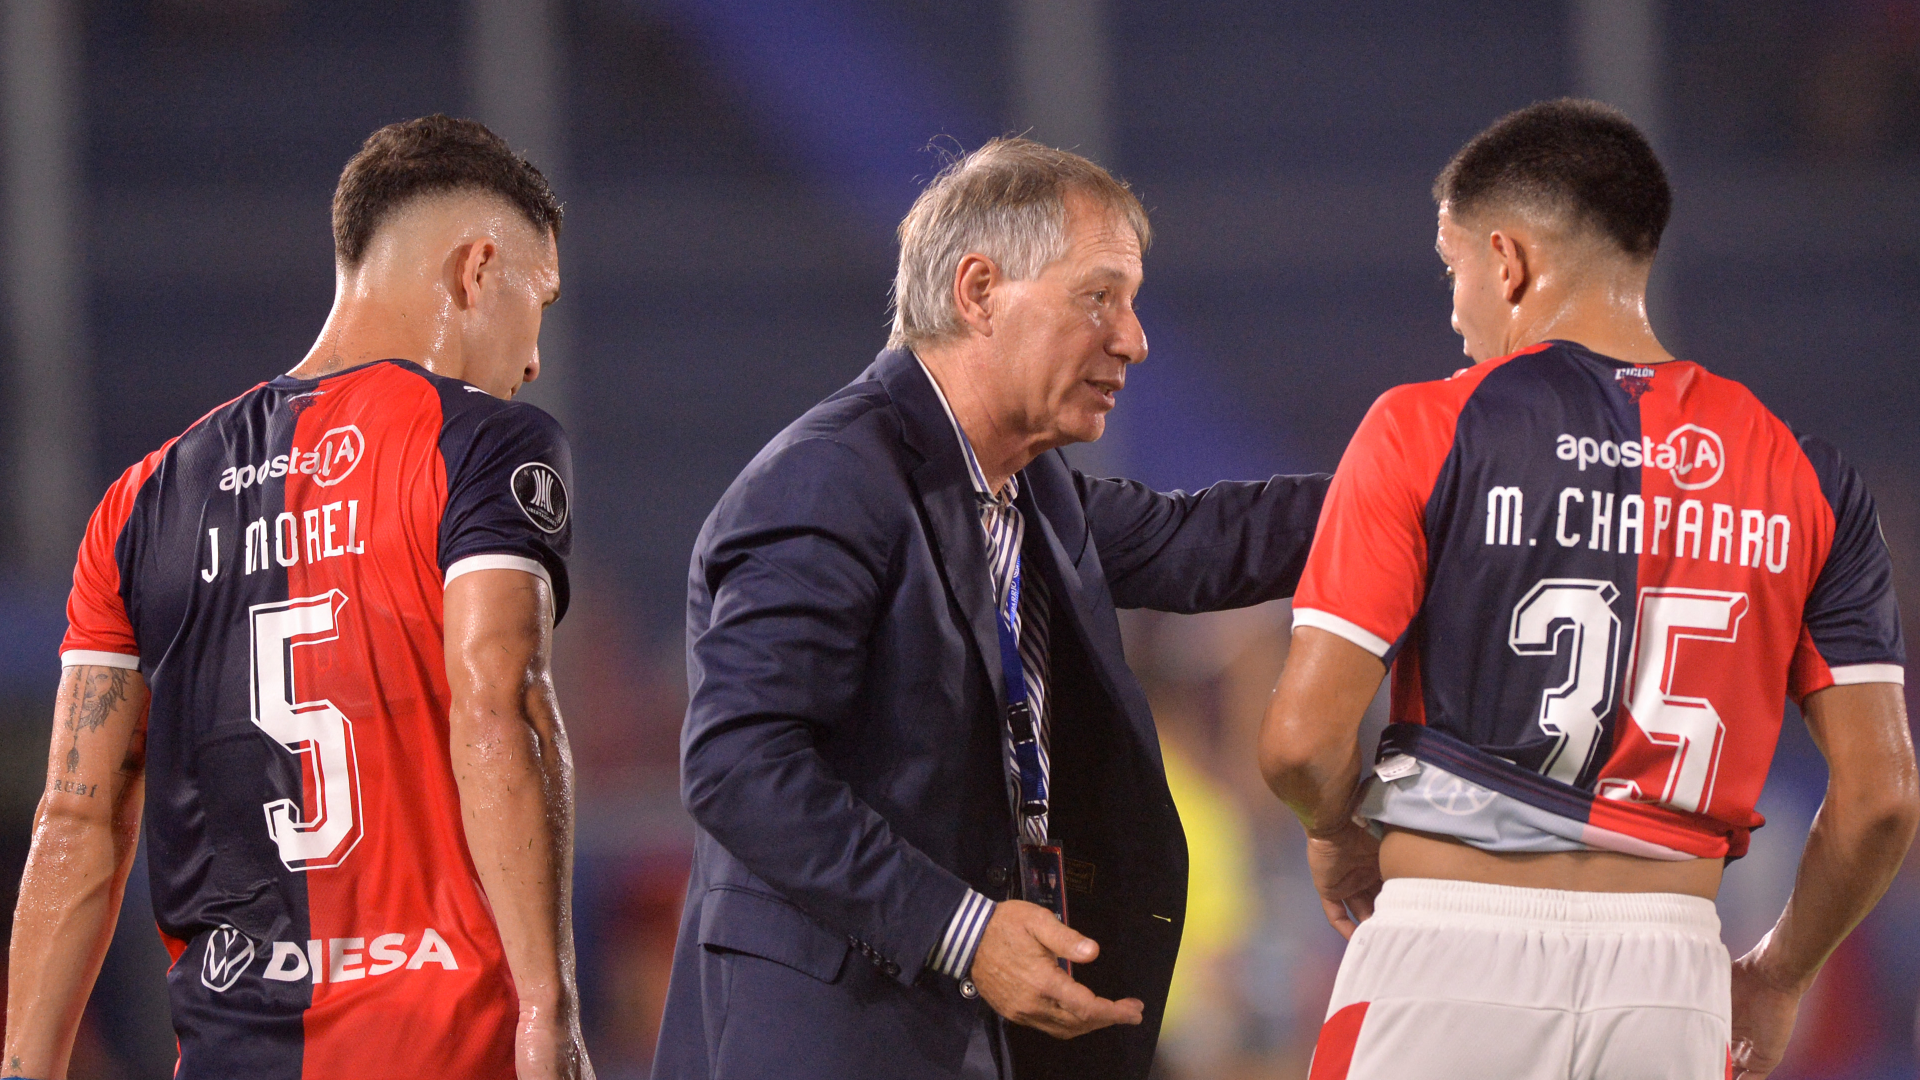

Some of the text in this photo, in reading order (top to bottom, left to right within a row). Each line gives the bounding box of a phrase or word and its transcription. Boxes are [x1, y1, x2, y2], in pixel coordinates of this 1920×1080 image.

[245, 499, 365, 576] MOREL
[1485, 486, 1791, 574] M. CHAPARRO
[249, 588, 364, 872] 5
[1508, 578, 1750, 814] 35
[263, 928, 459, 984] DIESA
